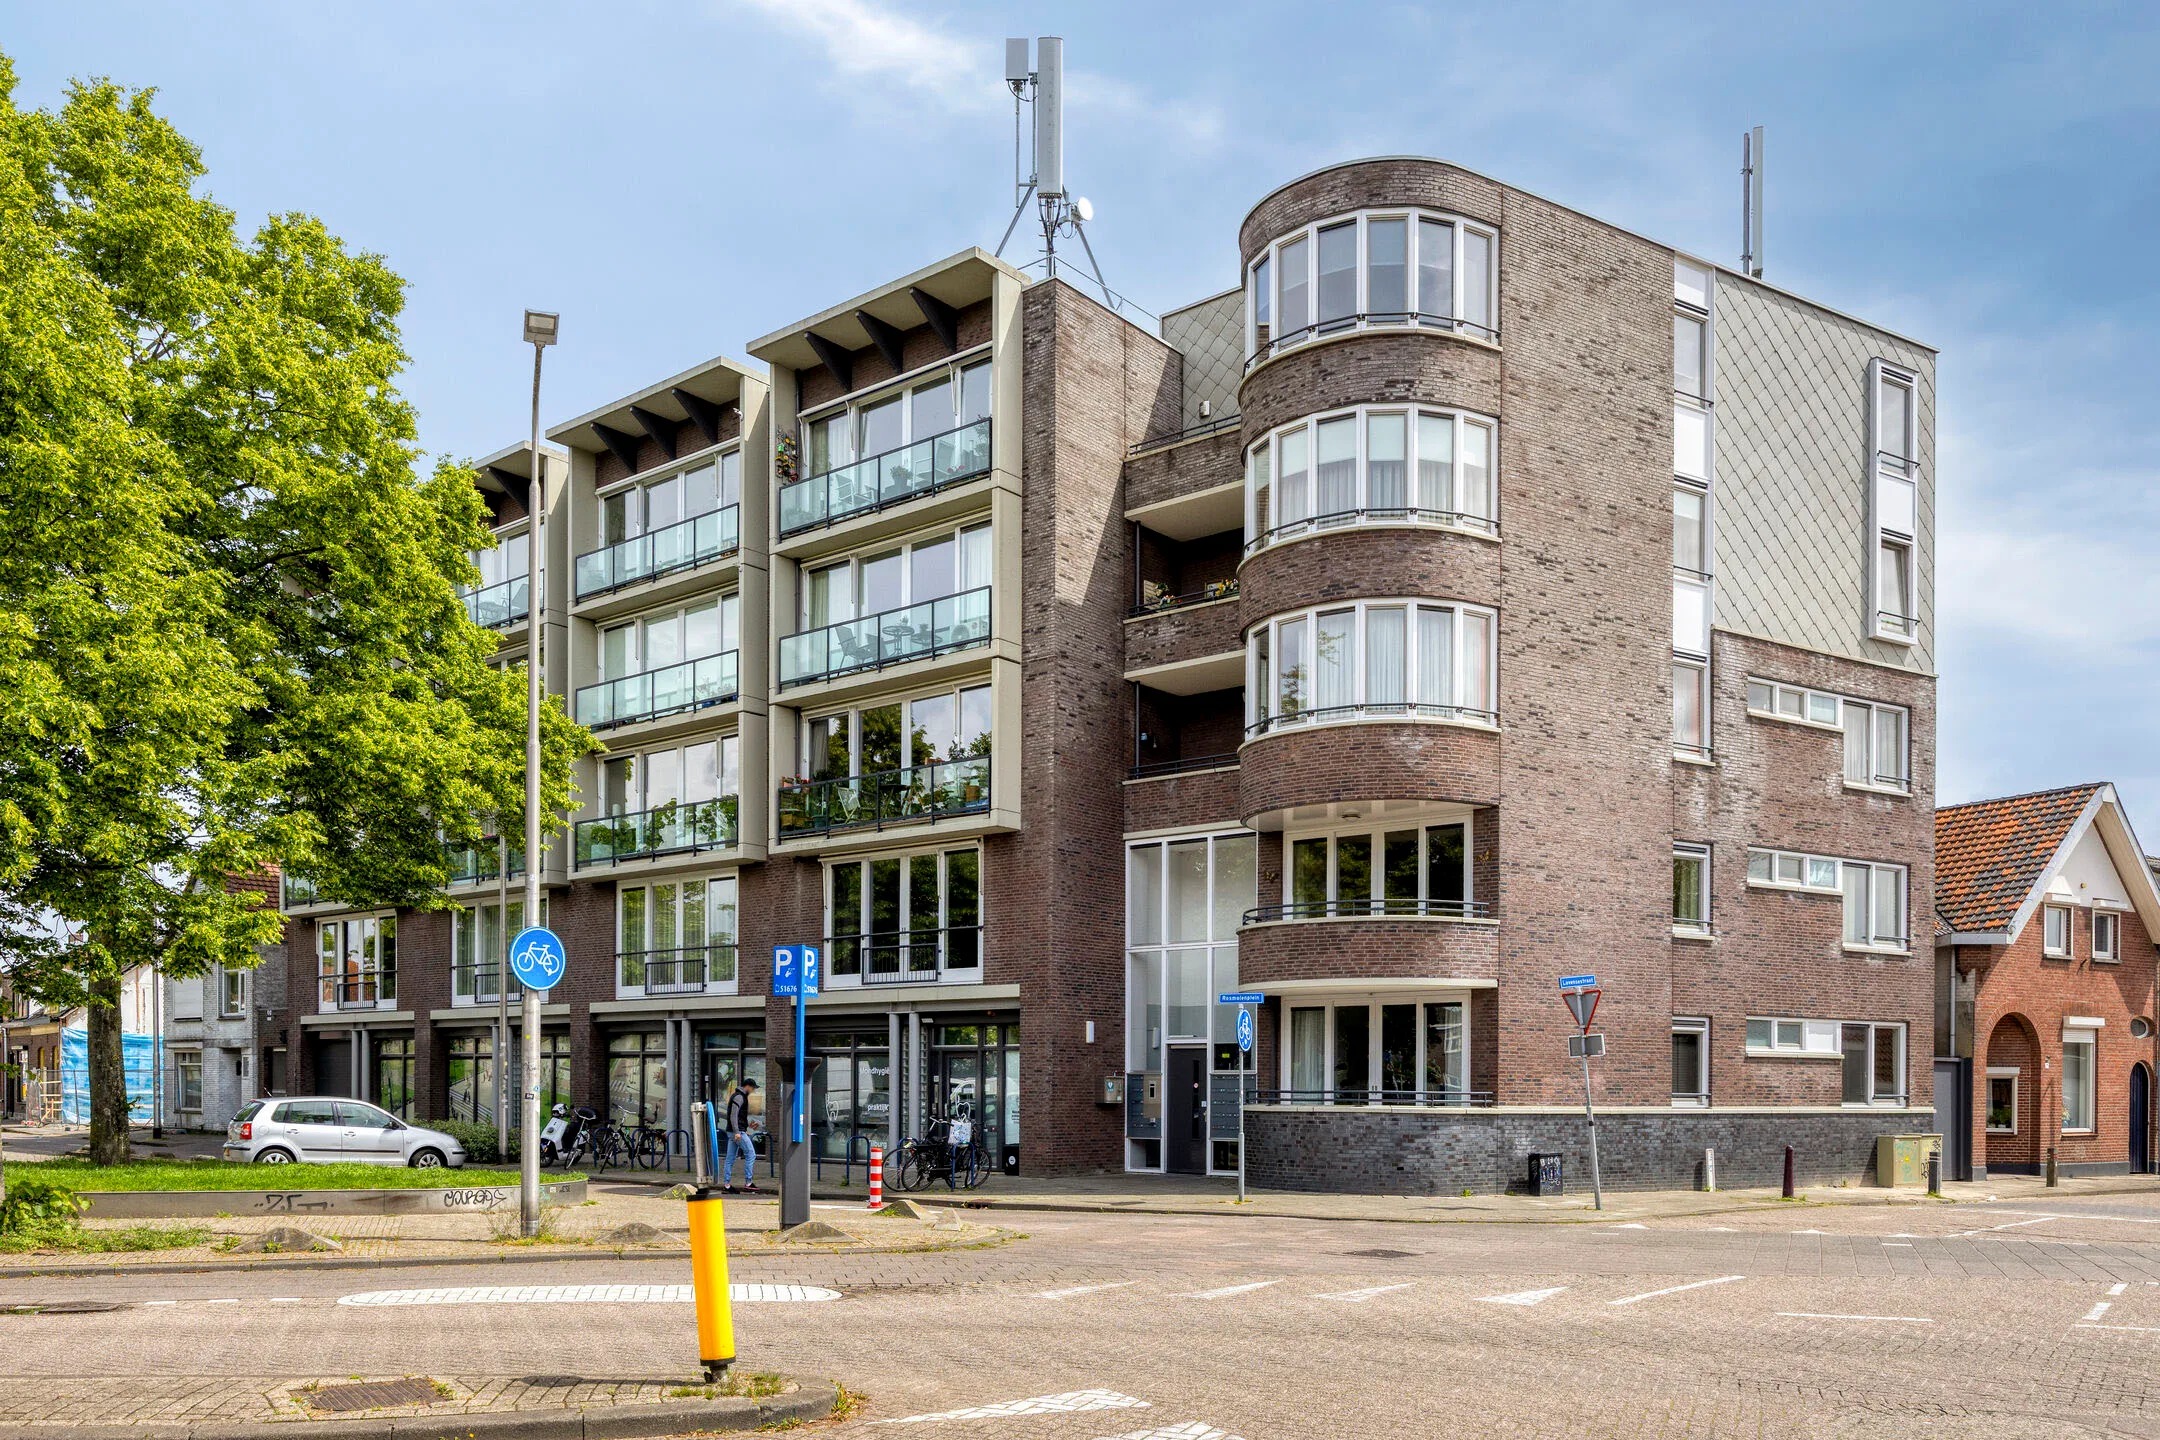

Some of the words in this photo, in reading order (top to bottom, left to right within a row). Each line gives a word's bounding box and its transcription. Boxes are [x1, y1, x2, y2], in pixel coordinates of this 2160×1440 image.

[775, 949, 792, 976] P
[804, 949, 815, 976] P
[780, 985, 798, 993] 51676
